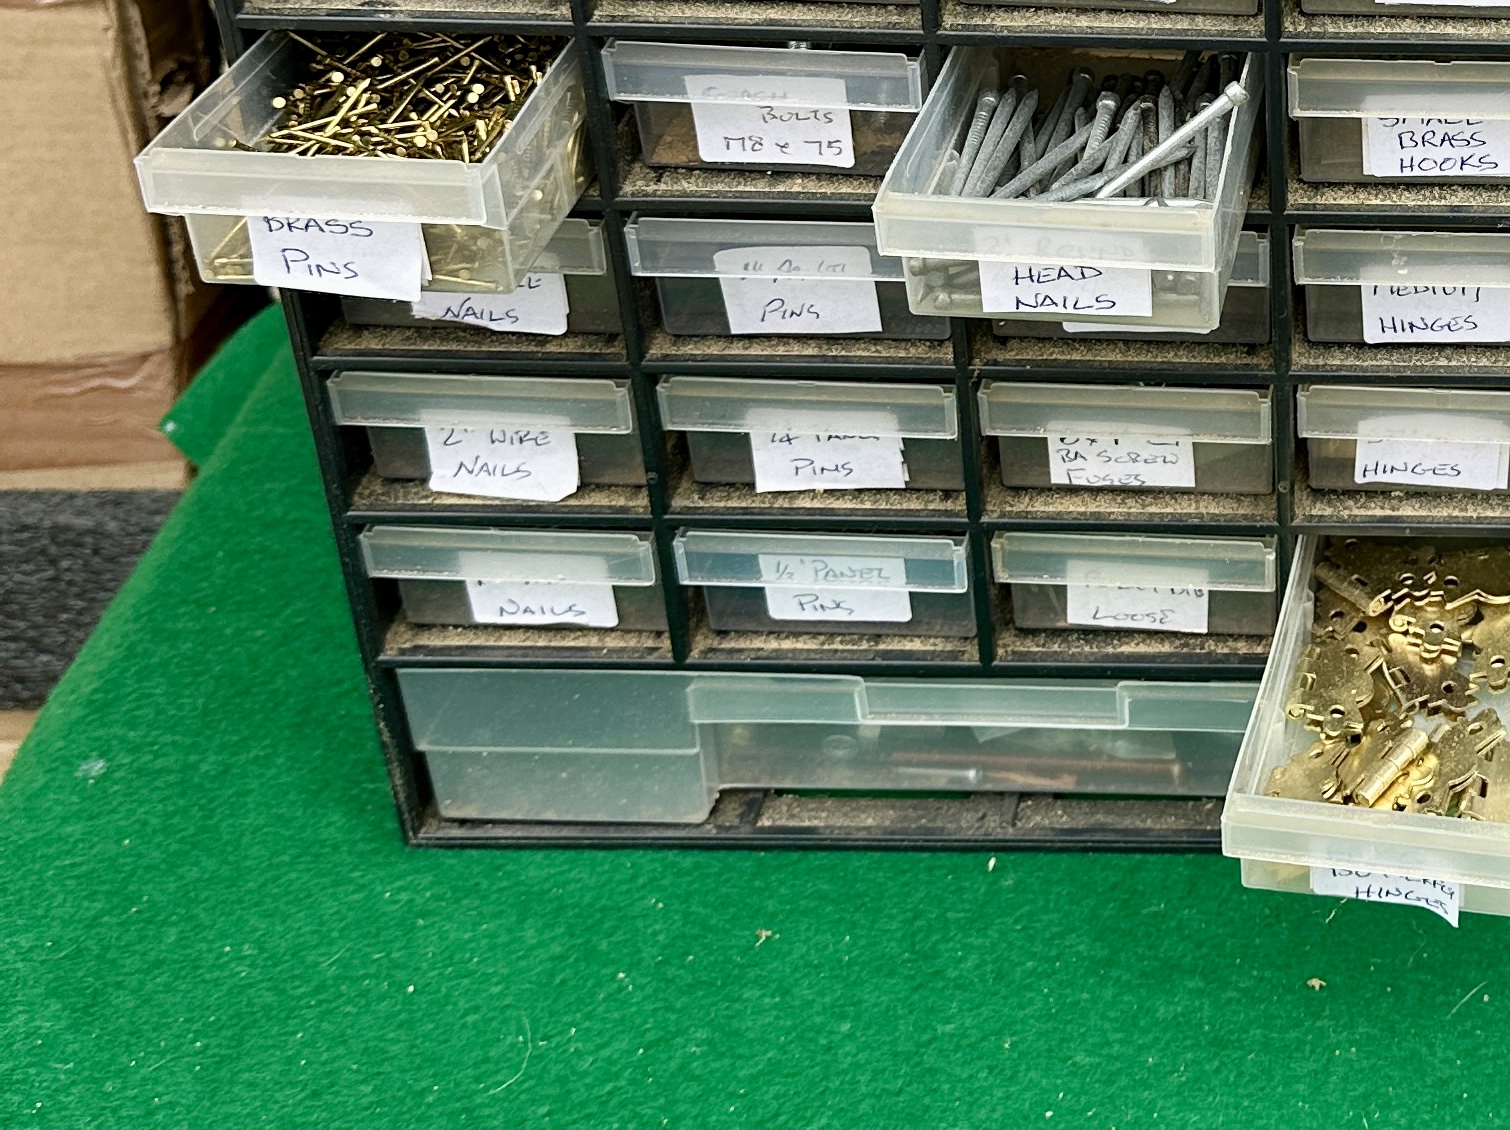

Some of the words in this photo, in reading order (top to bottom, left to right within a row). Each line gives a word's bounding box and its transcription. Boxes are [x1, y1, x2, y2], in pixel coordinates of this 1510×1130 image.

[760, 106, 835, 125] BOLTS
[804, 139, 844, 157] 75
[1397, 130, 1488, 149] BRASS
[1399, 153, 1500, 174] HOOKS
[264, 215, 374, 238] BRASS
[281, 247, 359, 280] PINS
[1012, 265, 1104, 286] HEAD
[441, 296, 519, 324] NAILS
[762, 298, 820, 323] PINS
[1015, 293, 1117, 312] NAILS
[1378, 313, 1478, 333] HINGES
[490, 429, 552, 448] WIRE
[454, 455, 534, 479] NAILS
[790, 458, 855, 477] PINS
[1097, 450, 1179, 465] SCREW
[1363, 461, 1461, 478] HINGES
[809, 559, 892, 581] PANEL
[499, 598, 587, 618] NAILS
[793, 593, 855, 616] PINS
[1092, 606, 1177, 625] LOOSE
